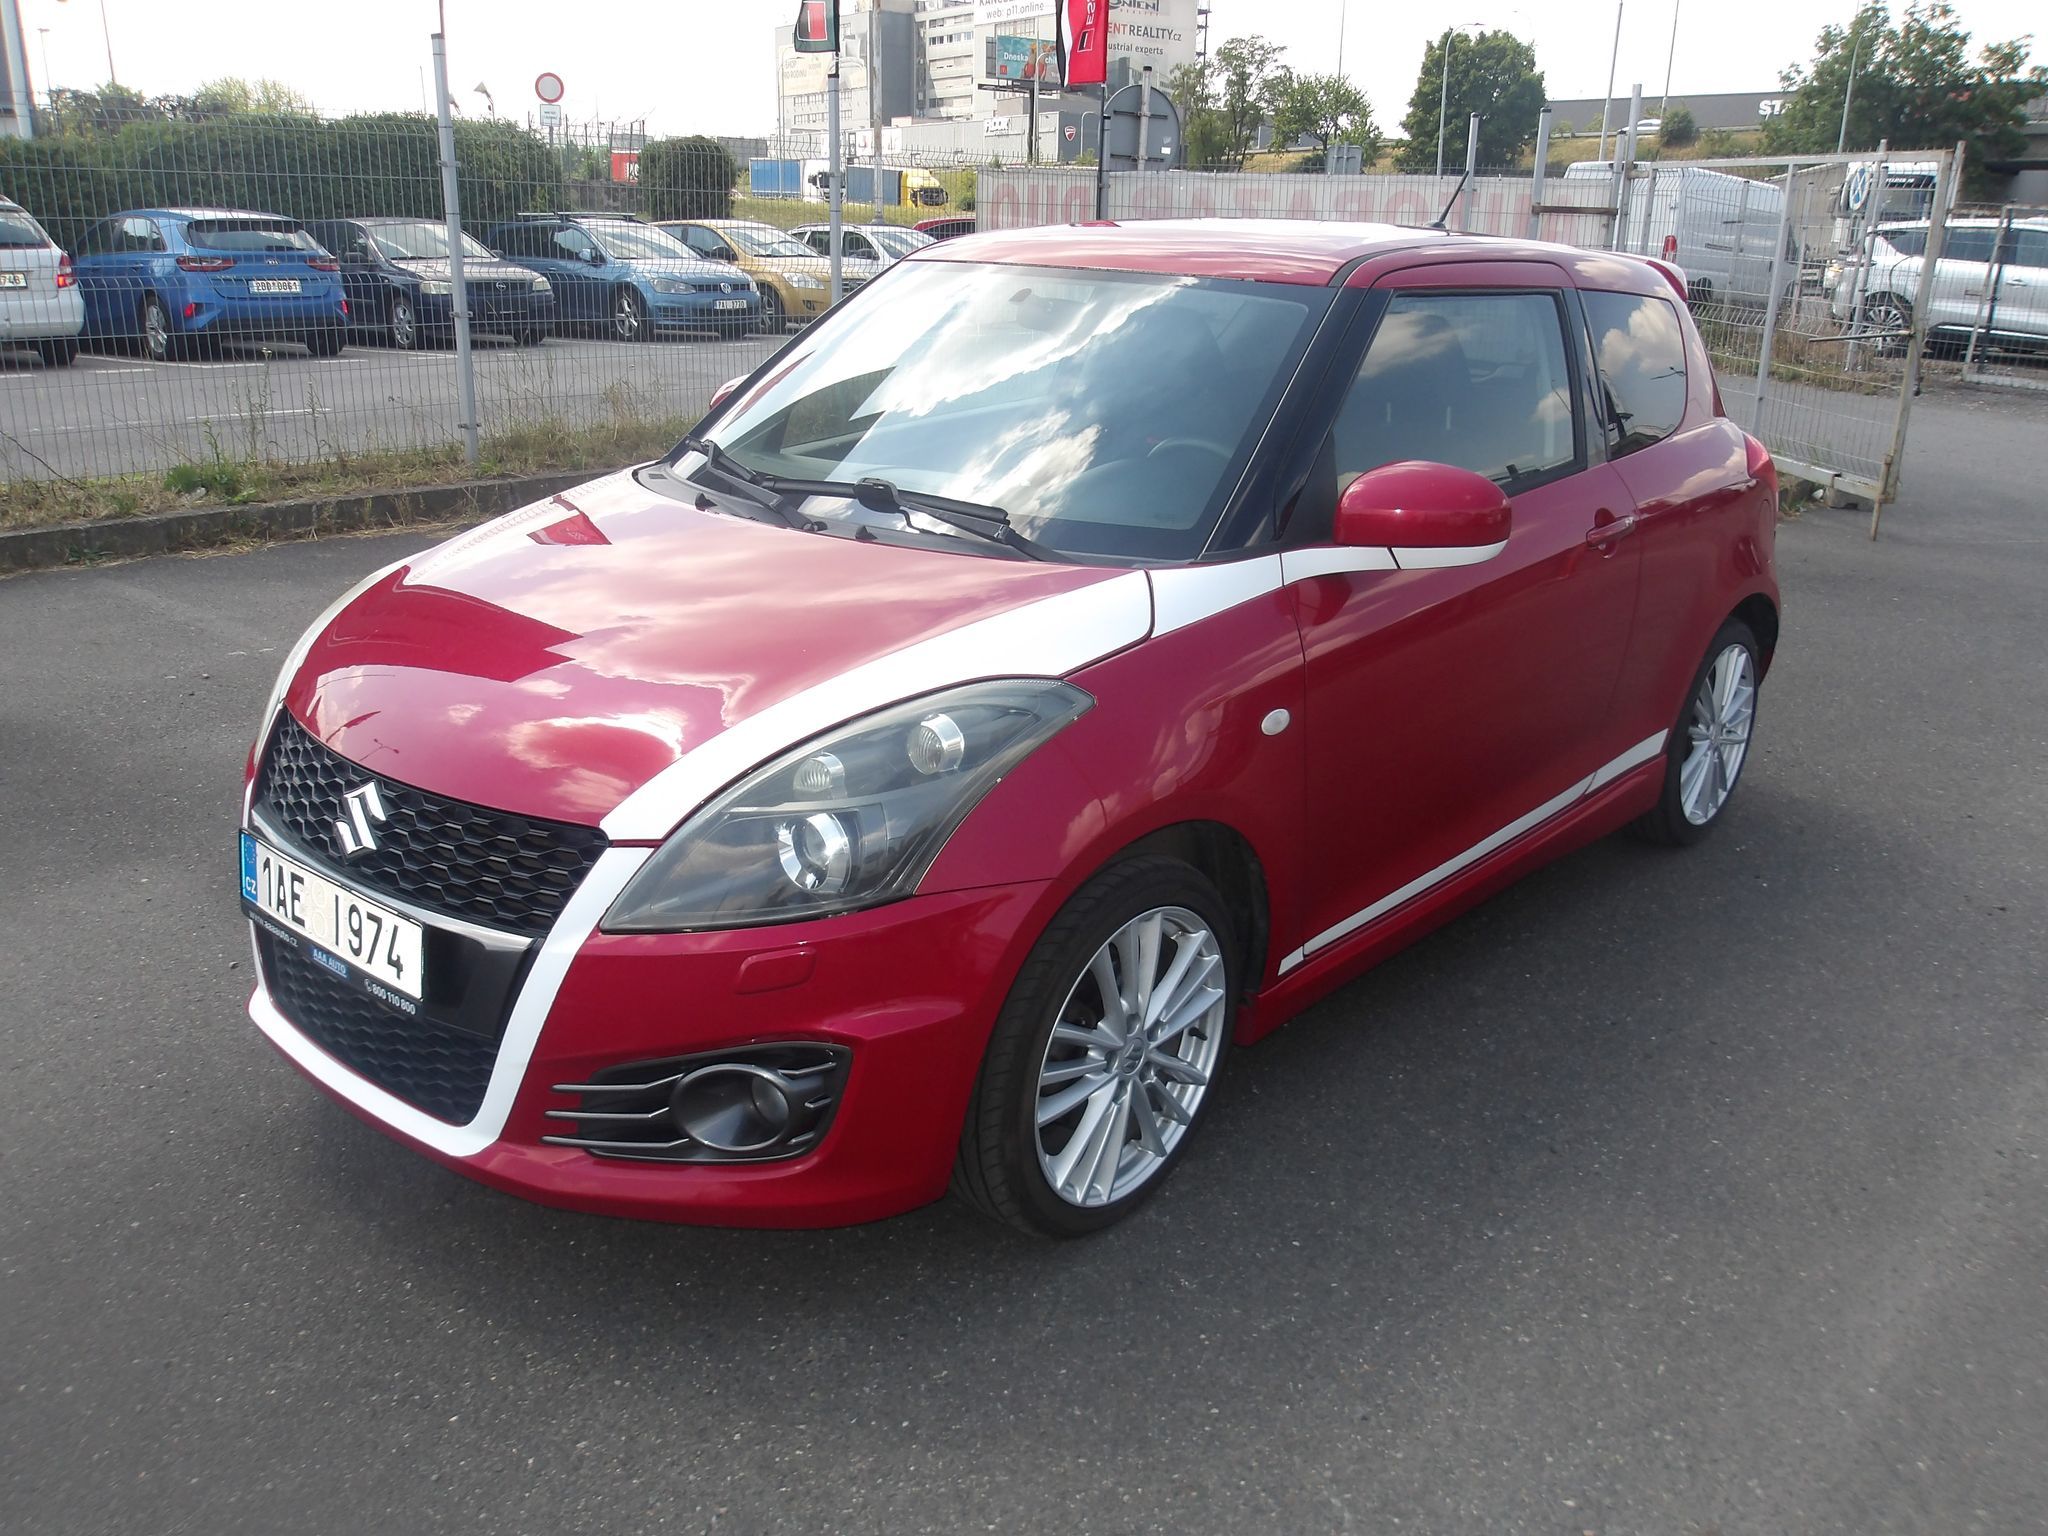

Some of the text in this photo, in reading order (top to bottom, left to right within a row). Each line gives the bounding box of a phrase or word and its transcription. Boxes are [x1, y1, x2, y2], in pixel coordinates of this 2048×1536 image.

[1006, 3, 1044, 18] p11.online
[1135, 45, 1164, 56] experts
[245, 876, 257, 894] CZ
[262, 857, 306, 929] 1AE
[313, 949, 346, 974] AAA AUTO
[387, 990, 400, 1007] 110
[400, 996, 416, 1015] 800
